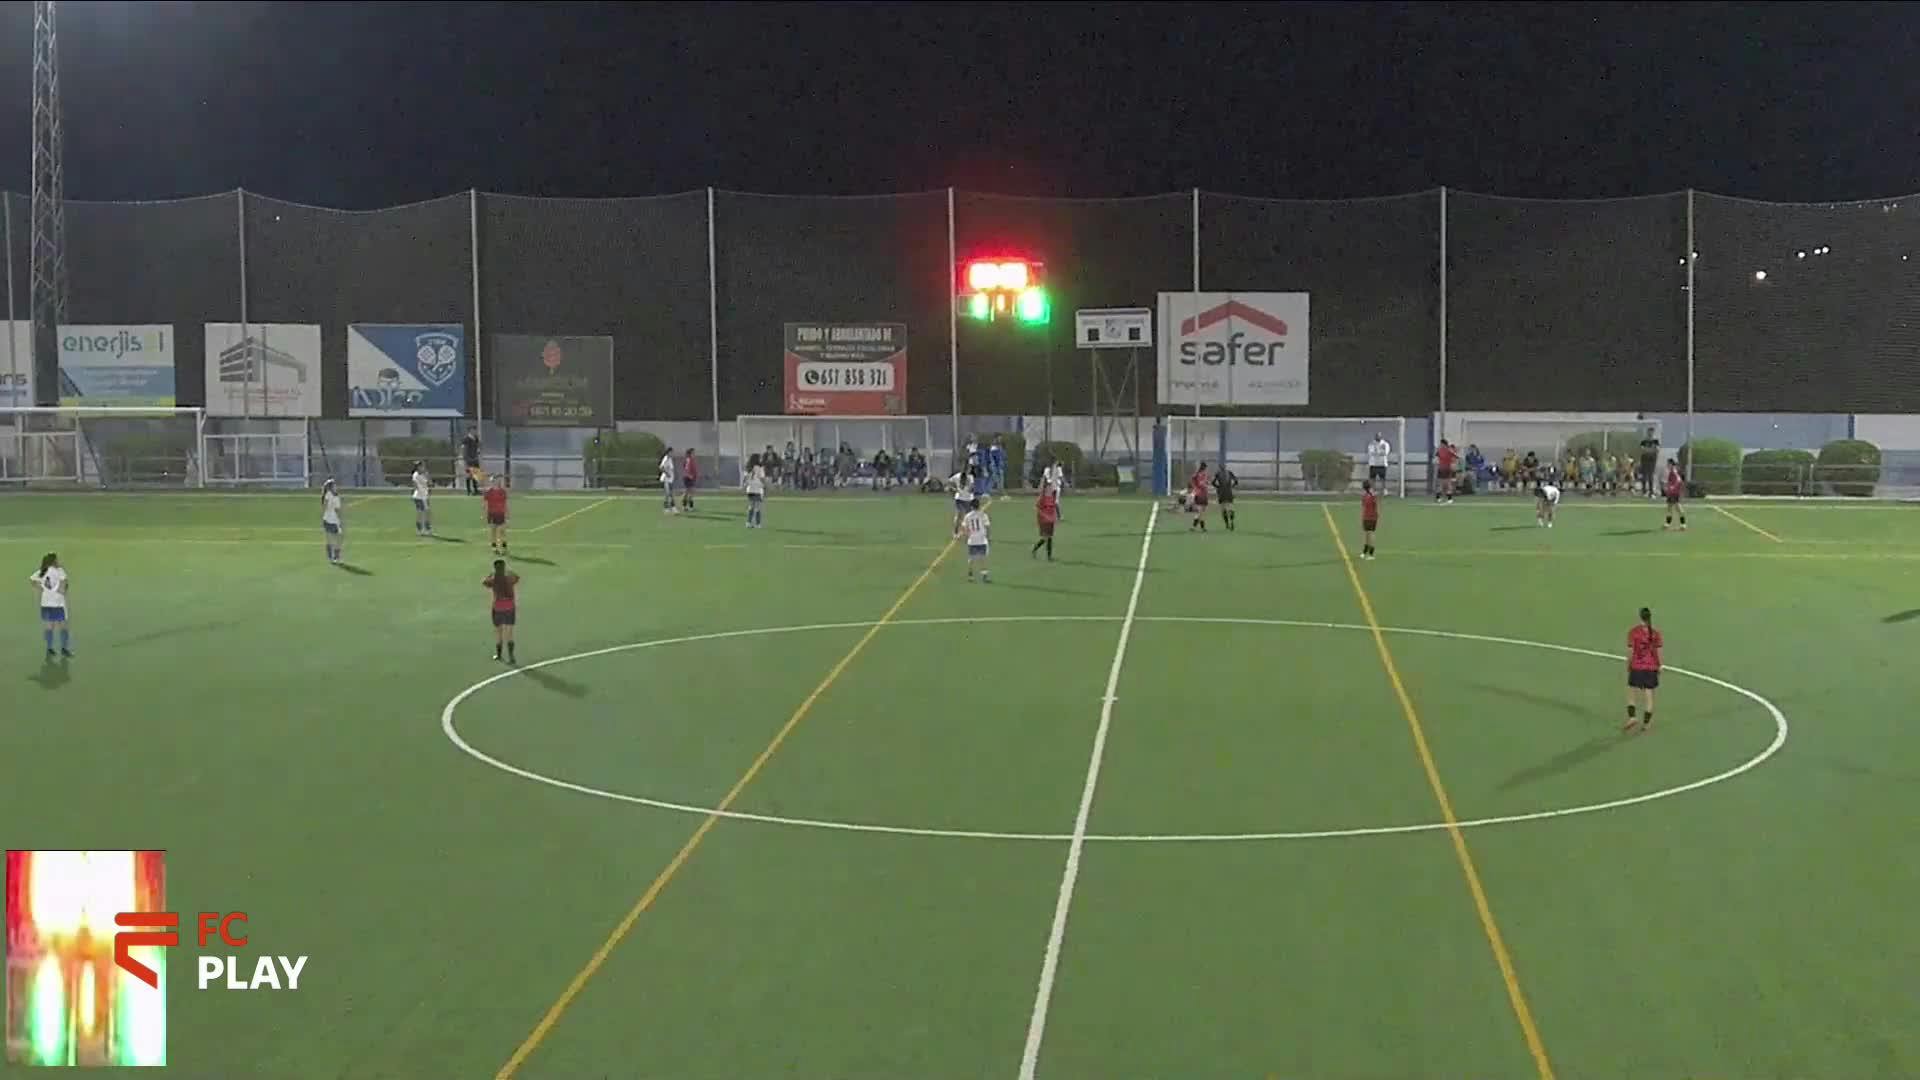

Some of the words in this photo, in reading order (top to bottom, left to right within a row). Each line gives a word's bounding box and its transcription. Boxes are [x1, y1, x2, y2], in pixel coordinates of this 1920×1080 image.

[63, 331, 164, 359] enerjisl
[1180, 332, 1285, 366] safer
[870, 368, 887, 385] 321
